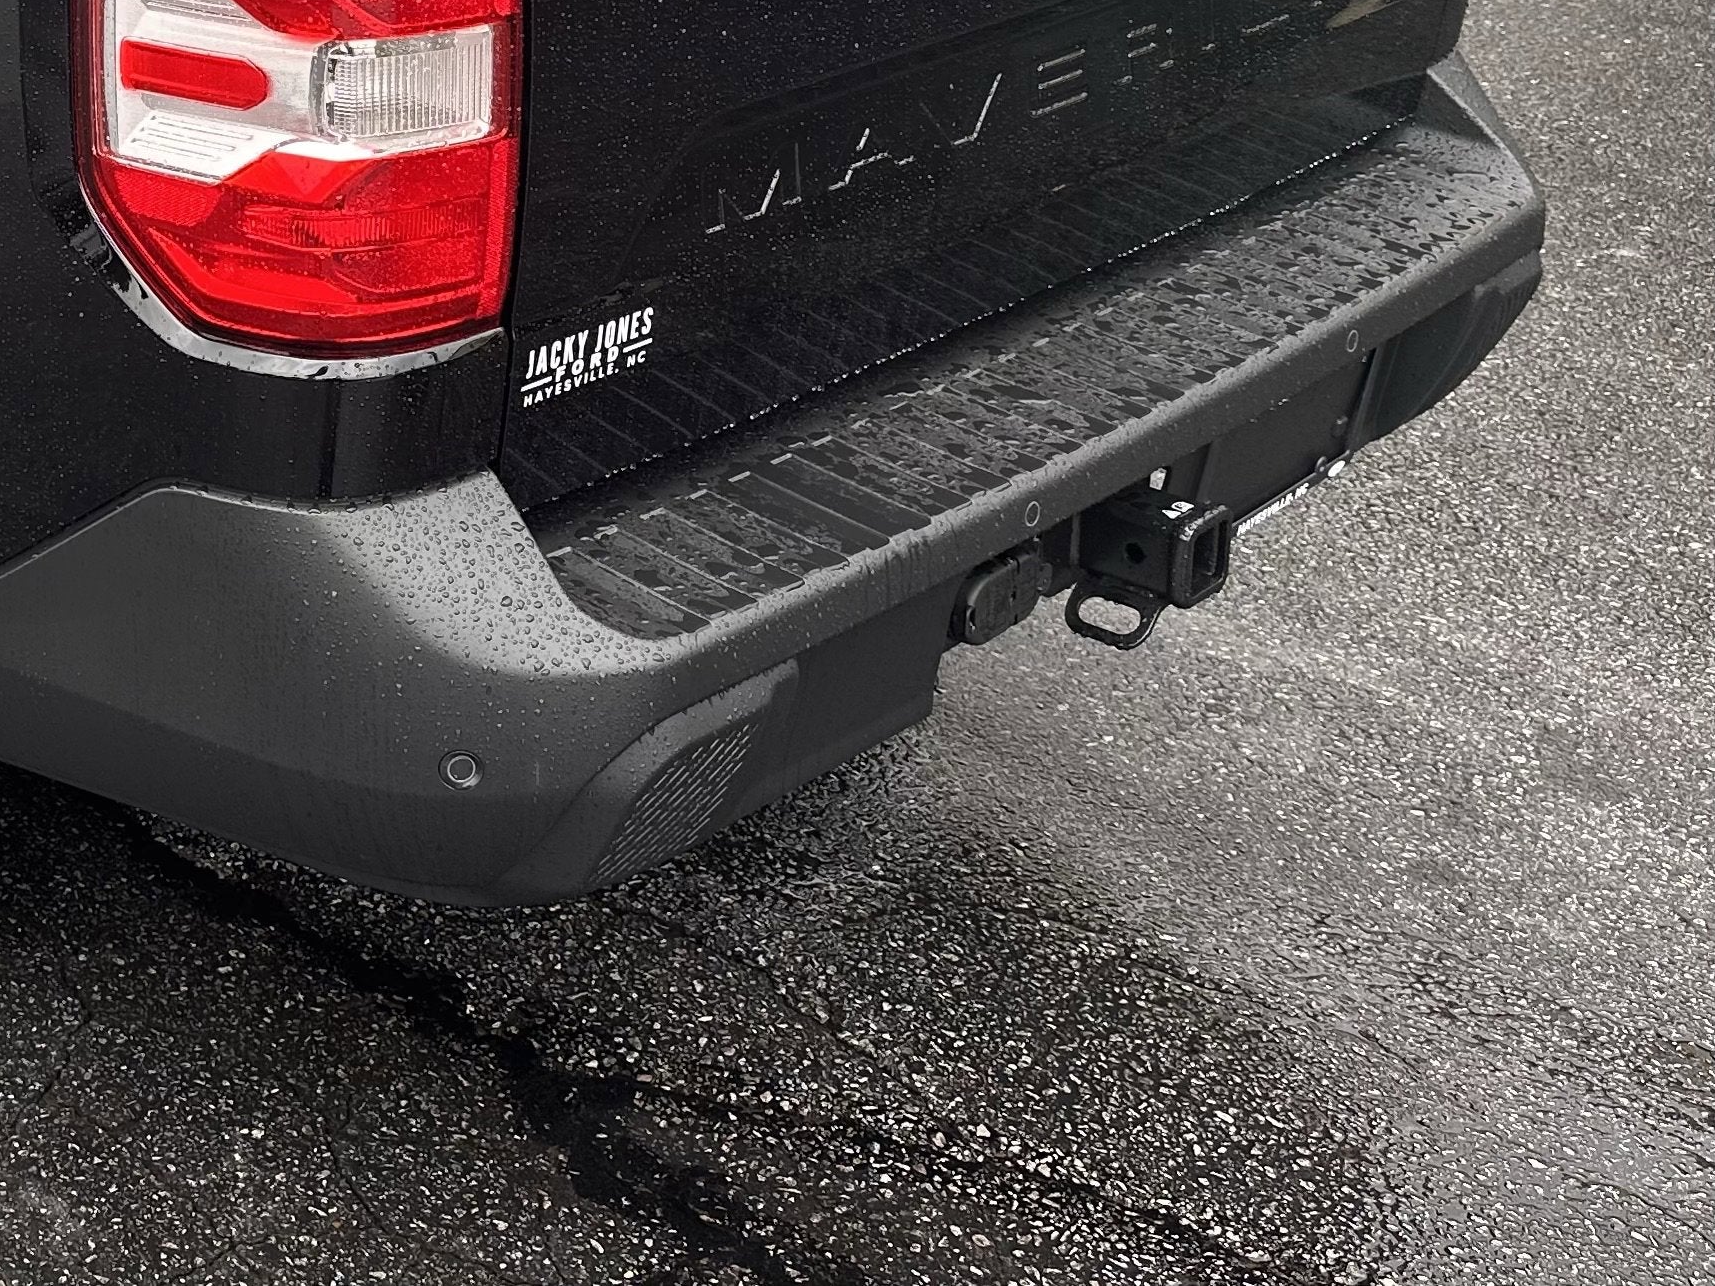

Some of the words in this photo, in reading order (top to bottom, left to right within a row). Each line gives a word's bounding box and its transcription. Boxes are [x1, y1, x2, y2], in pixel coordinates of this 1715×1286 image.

[525, 329, 590, 380] JACKY
[594, 306, 655, 353] JONES
[626, 350, 647, 368] NC
[554, 345, 620, 383] FORD
